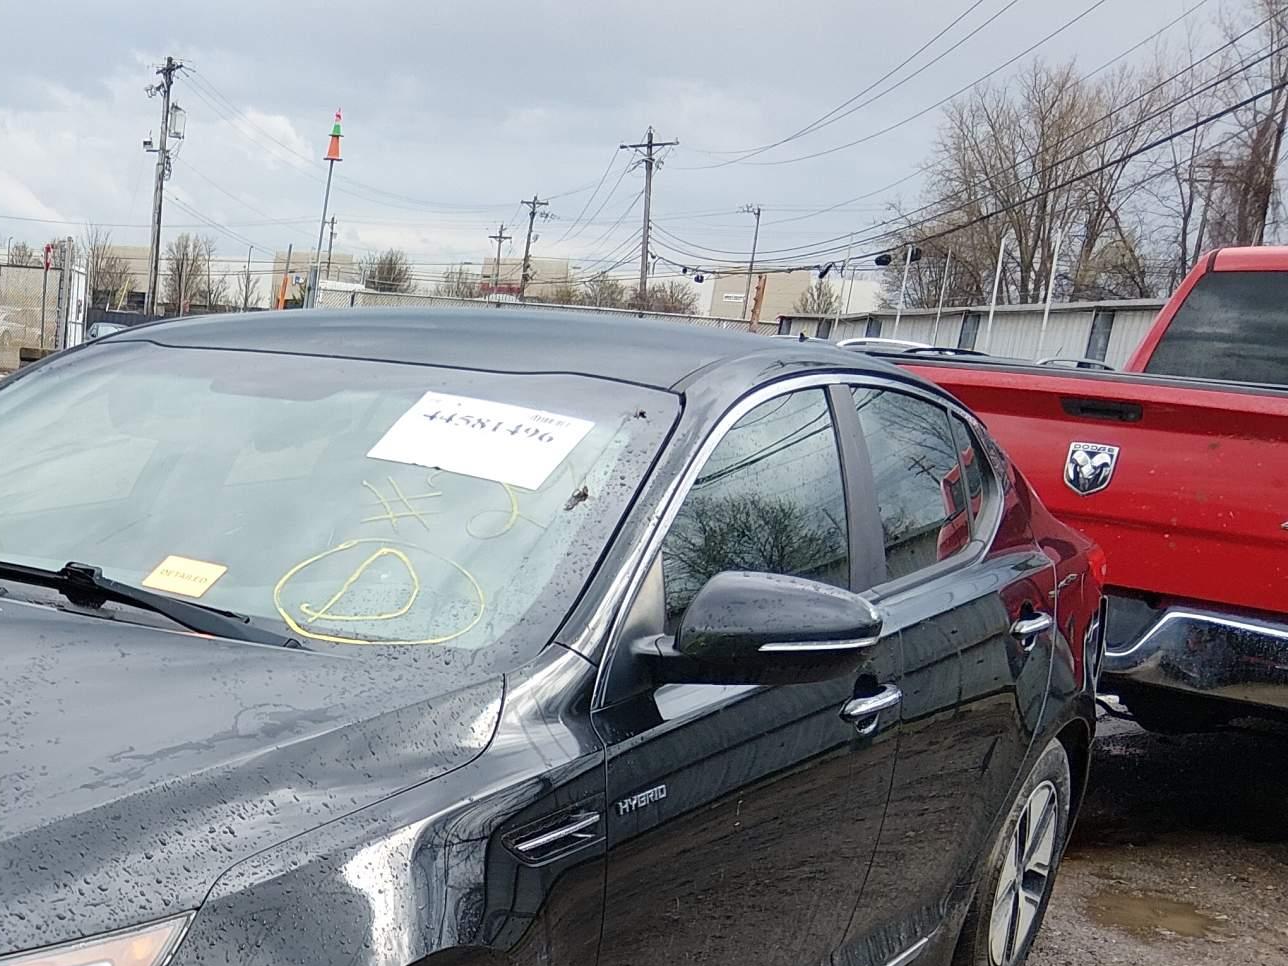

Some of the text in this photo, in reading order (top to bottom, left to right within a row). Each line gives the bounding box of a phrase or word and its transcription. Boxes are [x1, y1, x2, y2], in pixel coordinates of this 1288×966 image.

[423, 410, 554, 443] 44581496
[1073, 444, 1115, 453] DODGE
[618, 784, 667, 815] HYBRID
